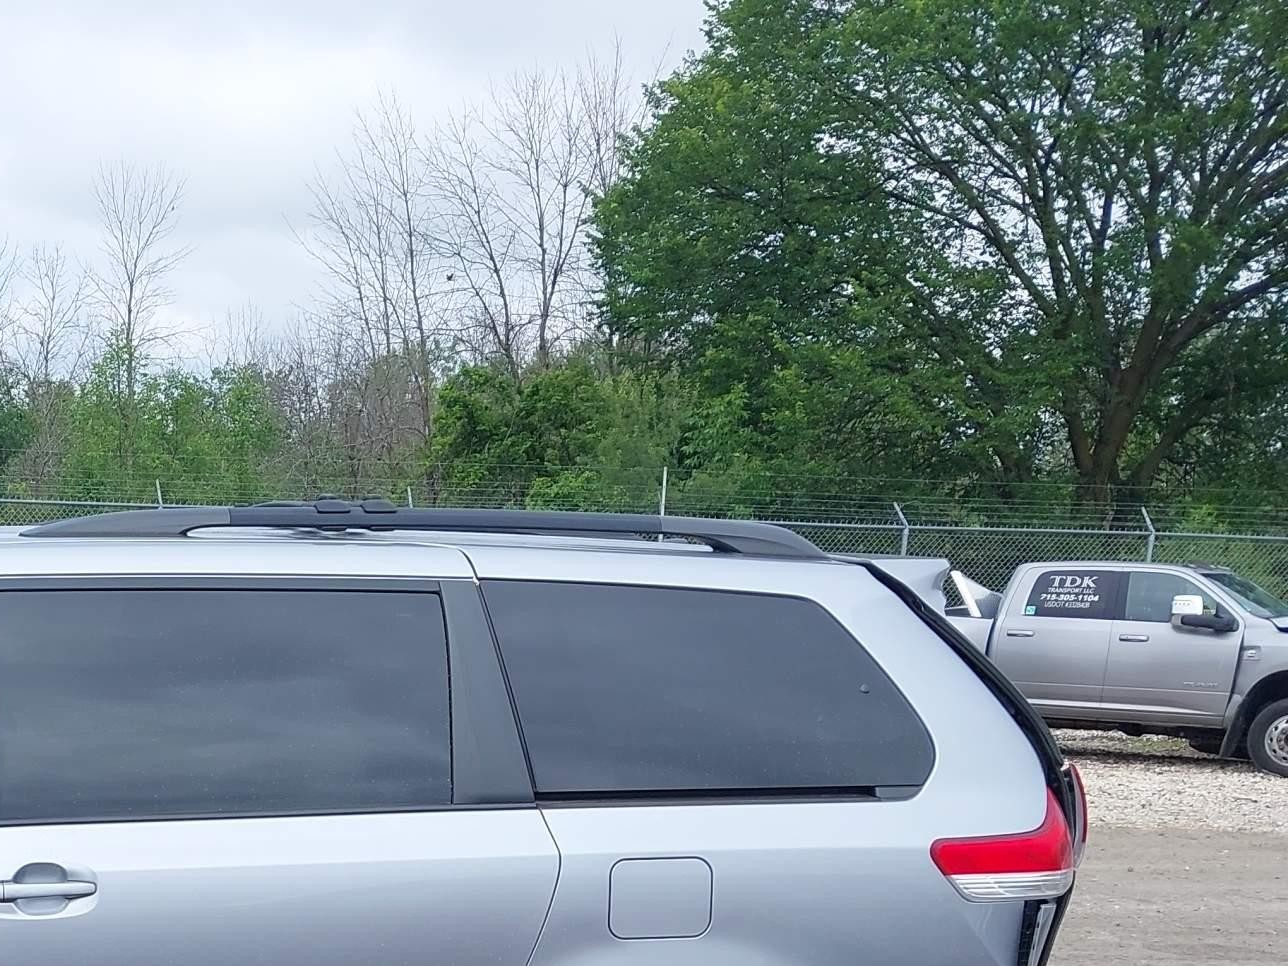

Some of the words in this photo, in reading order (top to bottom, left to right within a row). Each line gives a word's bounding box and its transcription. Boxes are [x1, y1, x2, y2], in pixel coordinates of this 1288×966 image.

[1049, 575, 1099, 588] TDK
[1039, 593, 1100, 602] 715-305-1104
[1044, 600, 1064, 608] USDOT
